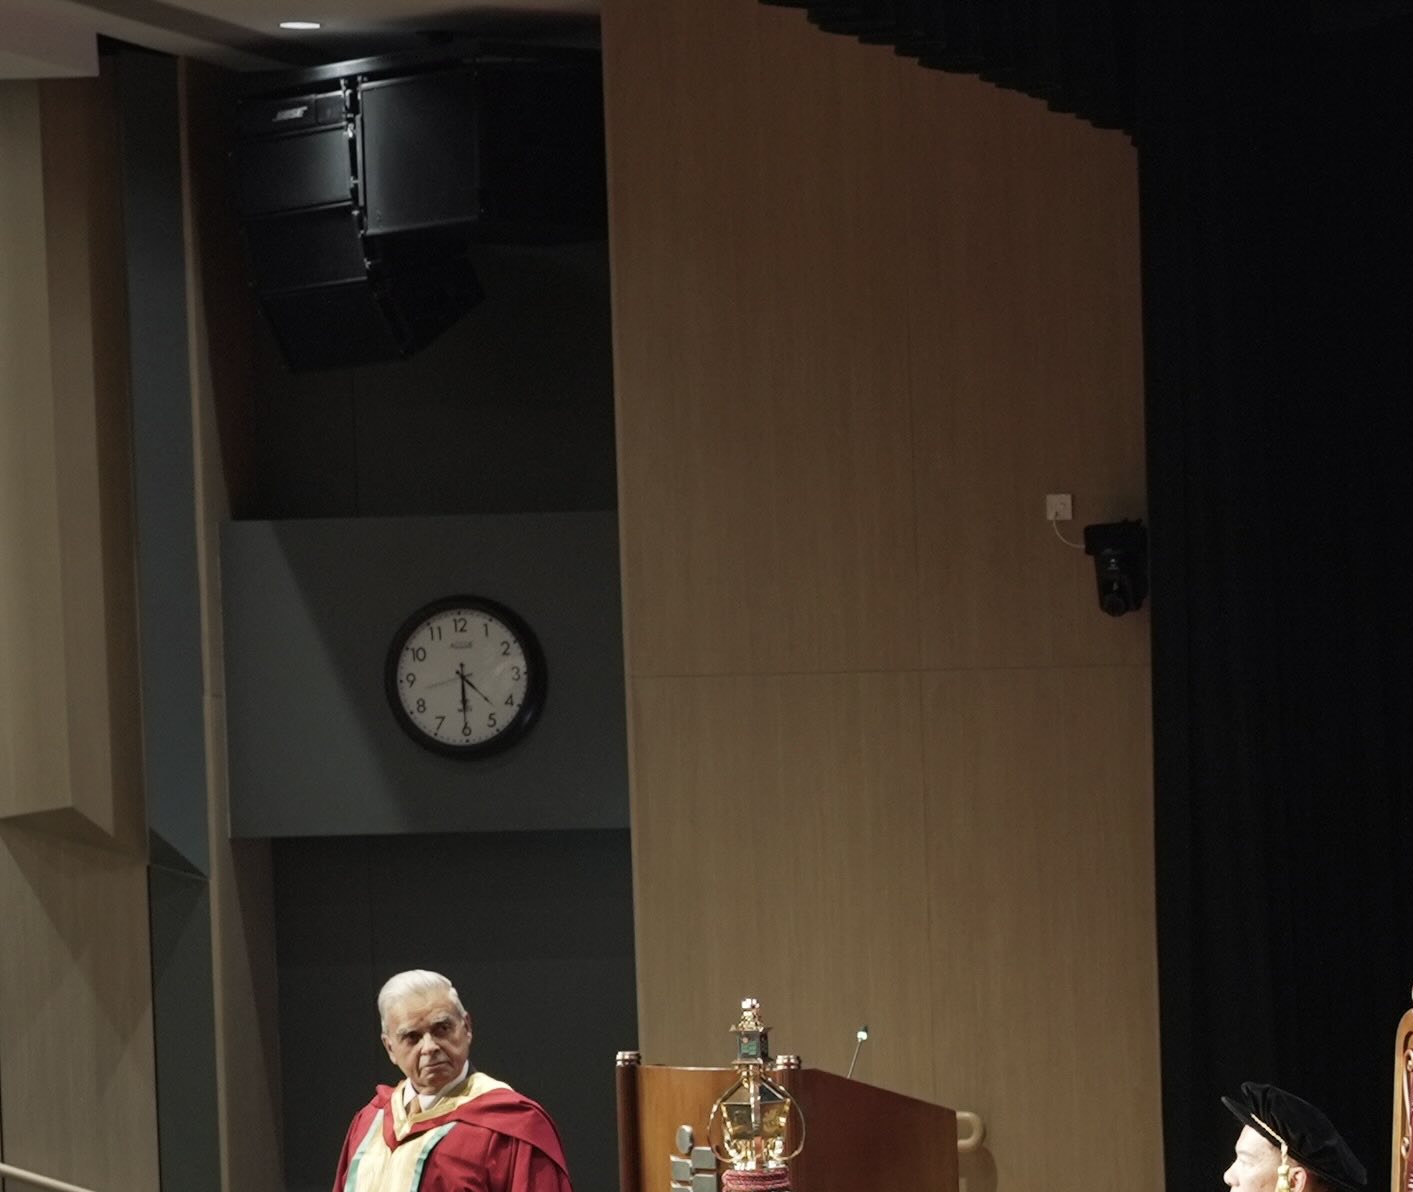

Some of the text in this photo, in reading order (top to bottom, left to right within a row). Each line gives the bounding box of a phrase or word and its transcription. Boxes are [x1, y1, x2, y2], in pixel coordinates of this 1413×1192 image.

[453, 617, 468, 633] 12
[483, 623, 489, 638] 1
[429, 626, 442, 641] 11
[412, 647, 427, 662] 10
[500, 640, 511, 657] 2
[406, 672, 416, 688] 9
[511, 666, 521, 682] 3
[416, 697, 426, 713] 8
[504, 694, 514, 707] 4
[435, 715, 446, 731] 7
[487, 712, 497, 728] 5
[461, 721, 472, 737] 6
